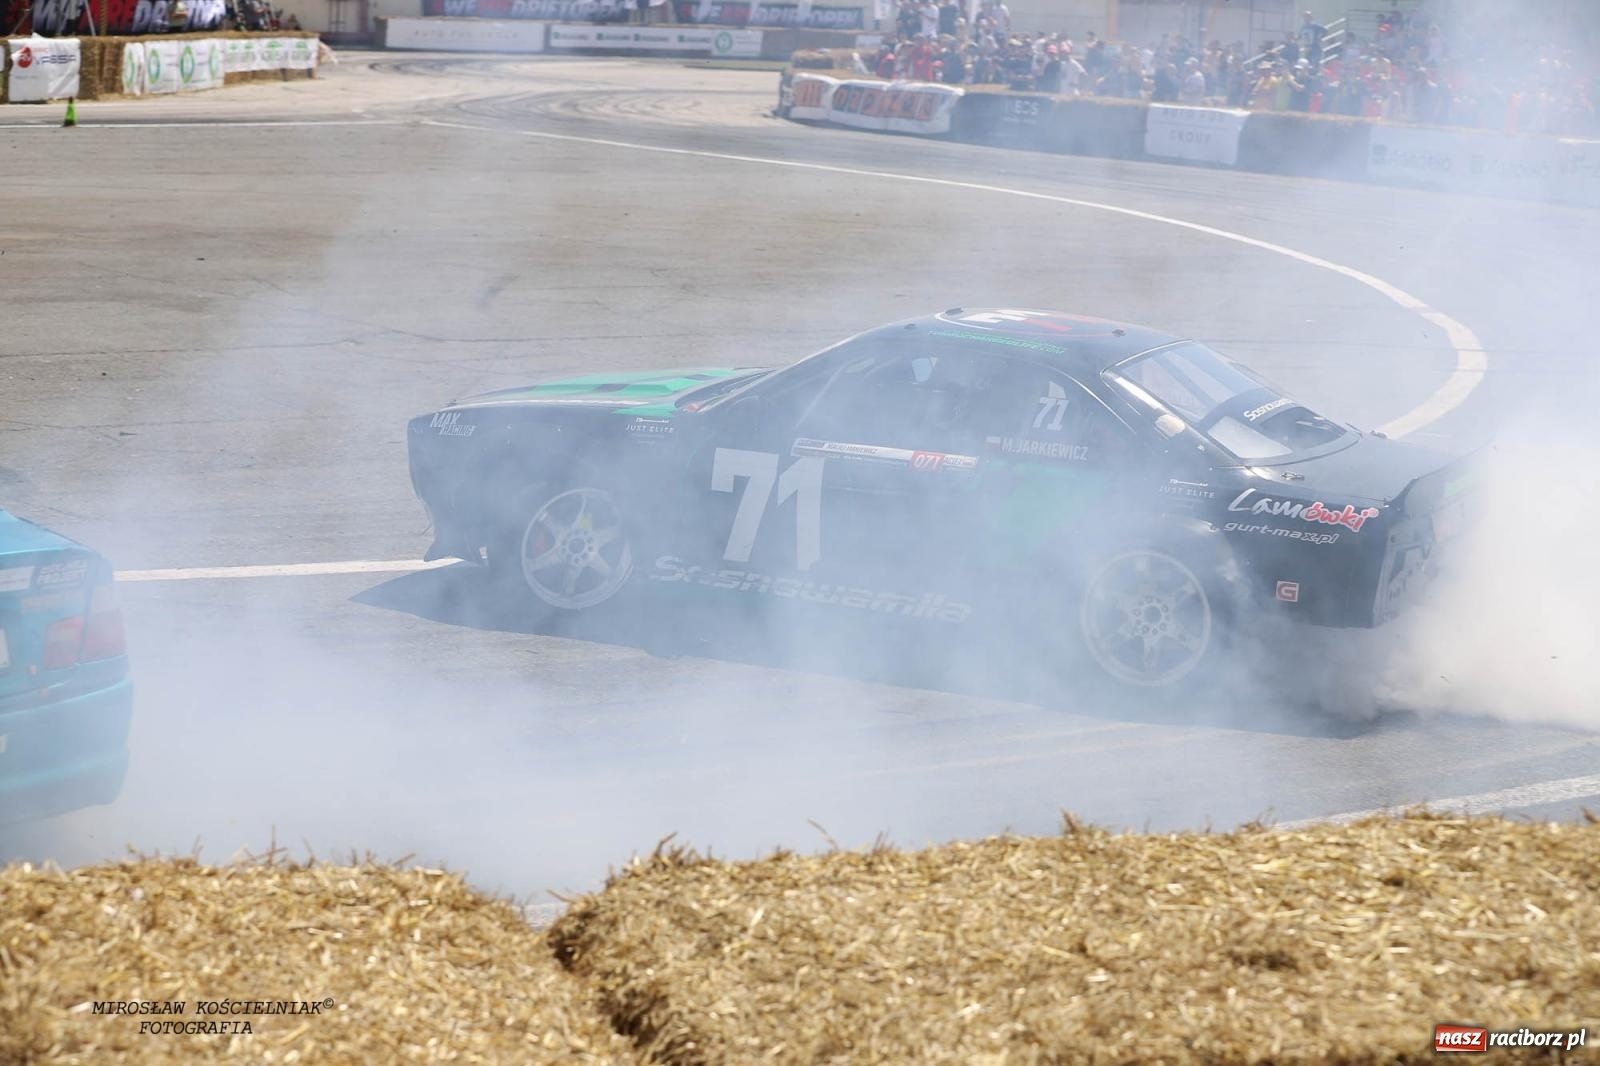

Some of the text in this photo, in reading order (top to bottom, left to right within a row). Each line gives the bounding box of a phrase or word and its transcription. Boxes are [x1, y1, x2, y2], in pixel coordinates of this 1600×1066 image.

[1032, 396, 1070, 431] 71
[625, 424, 675, 434] JUST ELITE
[1001, 437, 1088, 461] M.JARKIEWICZ
[914, 454, 941, 471] 071
[1185, 490, 1216, 499] ELITE
[711, 447, 825, 570] 71
[1228, 488, 1364, 533] Lamówki
[1223, 520, 1340, 545] gurt-max.pl
